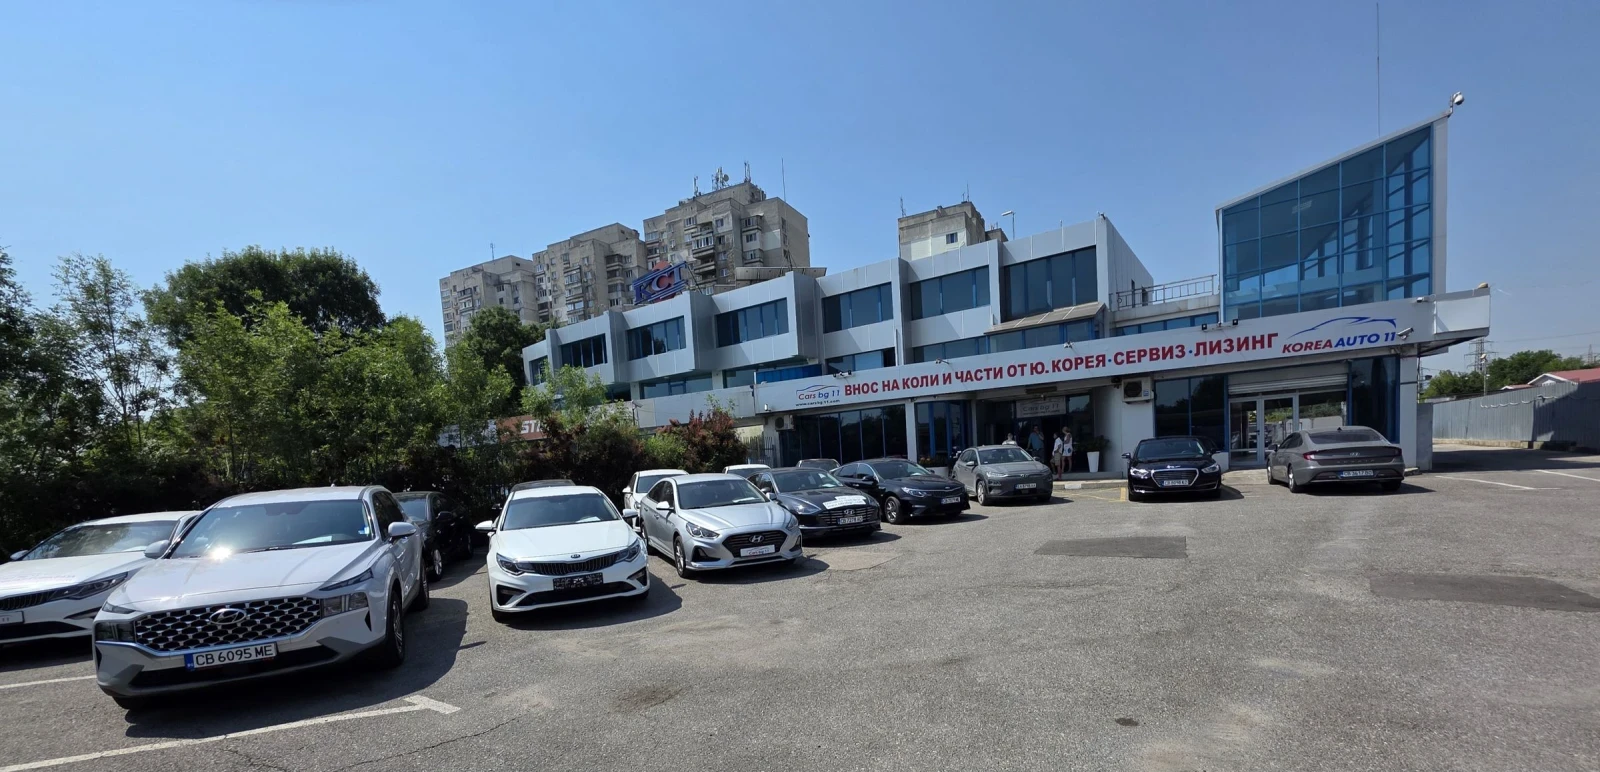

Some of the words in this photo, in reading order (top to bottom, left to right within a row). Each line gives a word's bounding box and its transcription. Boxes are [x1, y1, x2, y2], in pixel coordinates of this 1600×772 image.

[1282, 339, 1333, 353] KOREA
[1334, 333, 1380, 348] AUTO
[1384, 332, 1396, 342] 11
[844, 382, 879, 396] ВНОС
[882, 379, 900, 392] НА
[902, 374, 939, 389] КОЛИ
[942, 373, 952, 385] И
[955, 366, 1004, 383] ЧАСТИ
[1007, 363, 1028, 377] ОТ
[1030, 361, 1050, 375] Ю.
[1051, 354, 1106, 373] КОРЕЯ
[1113, 344, 1186, 366] СЕРВИЗ
[1194, 332, 1279, 357] ЛИЗИНГ
[818, 391, 829, 399] bg
[832, 389, 840, 397] 11
[195, 653, 215, 666] CB
[218, 647, 252, 662] 6095
[254, 644, 274, 657] ME
